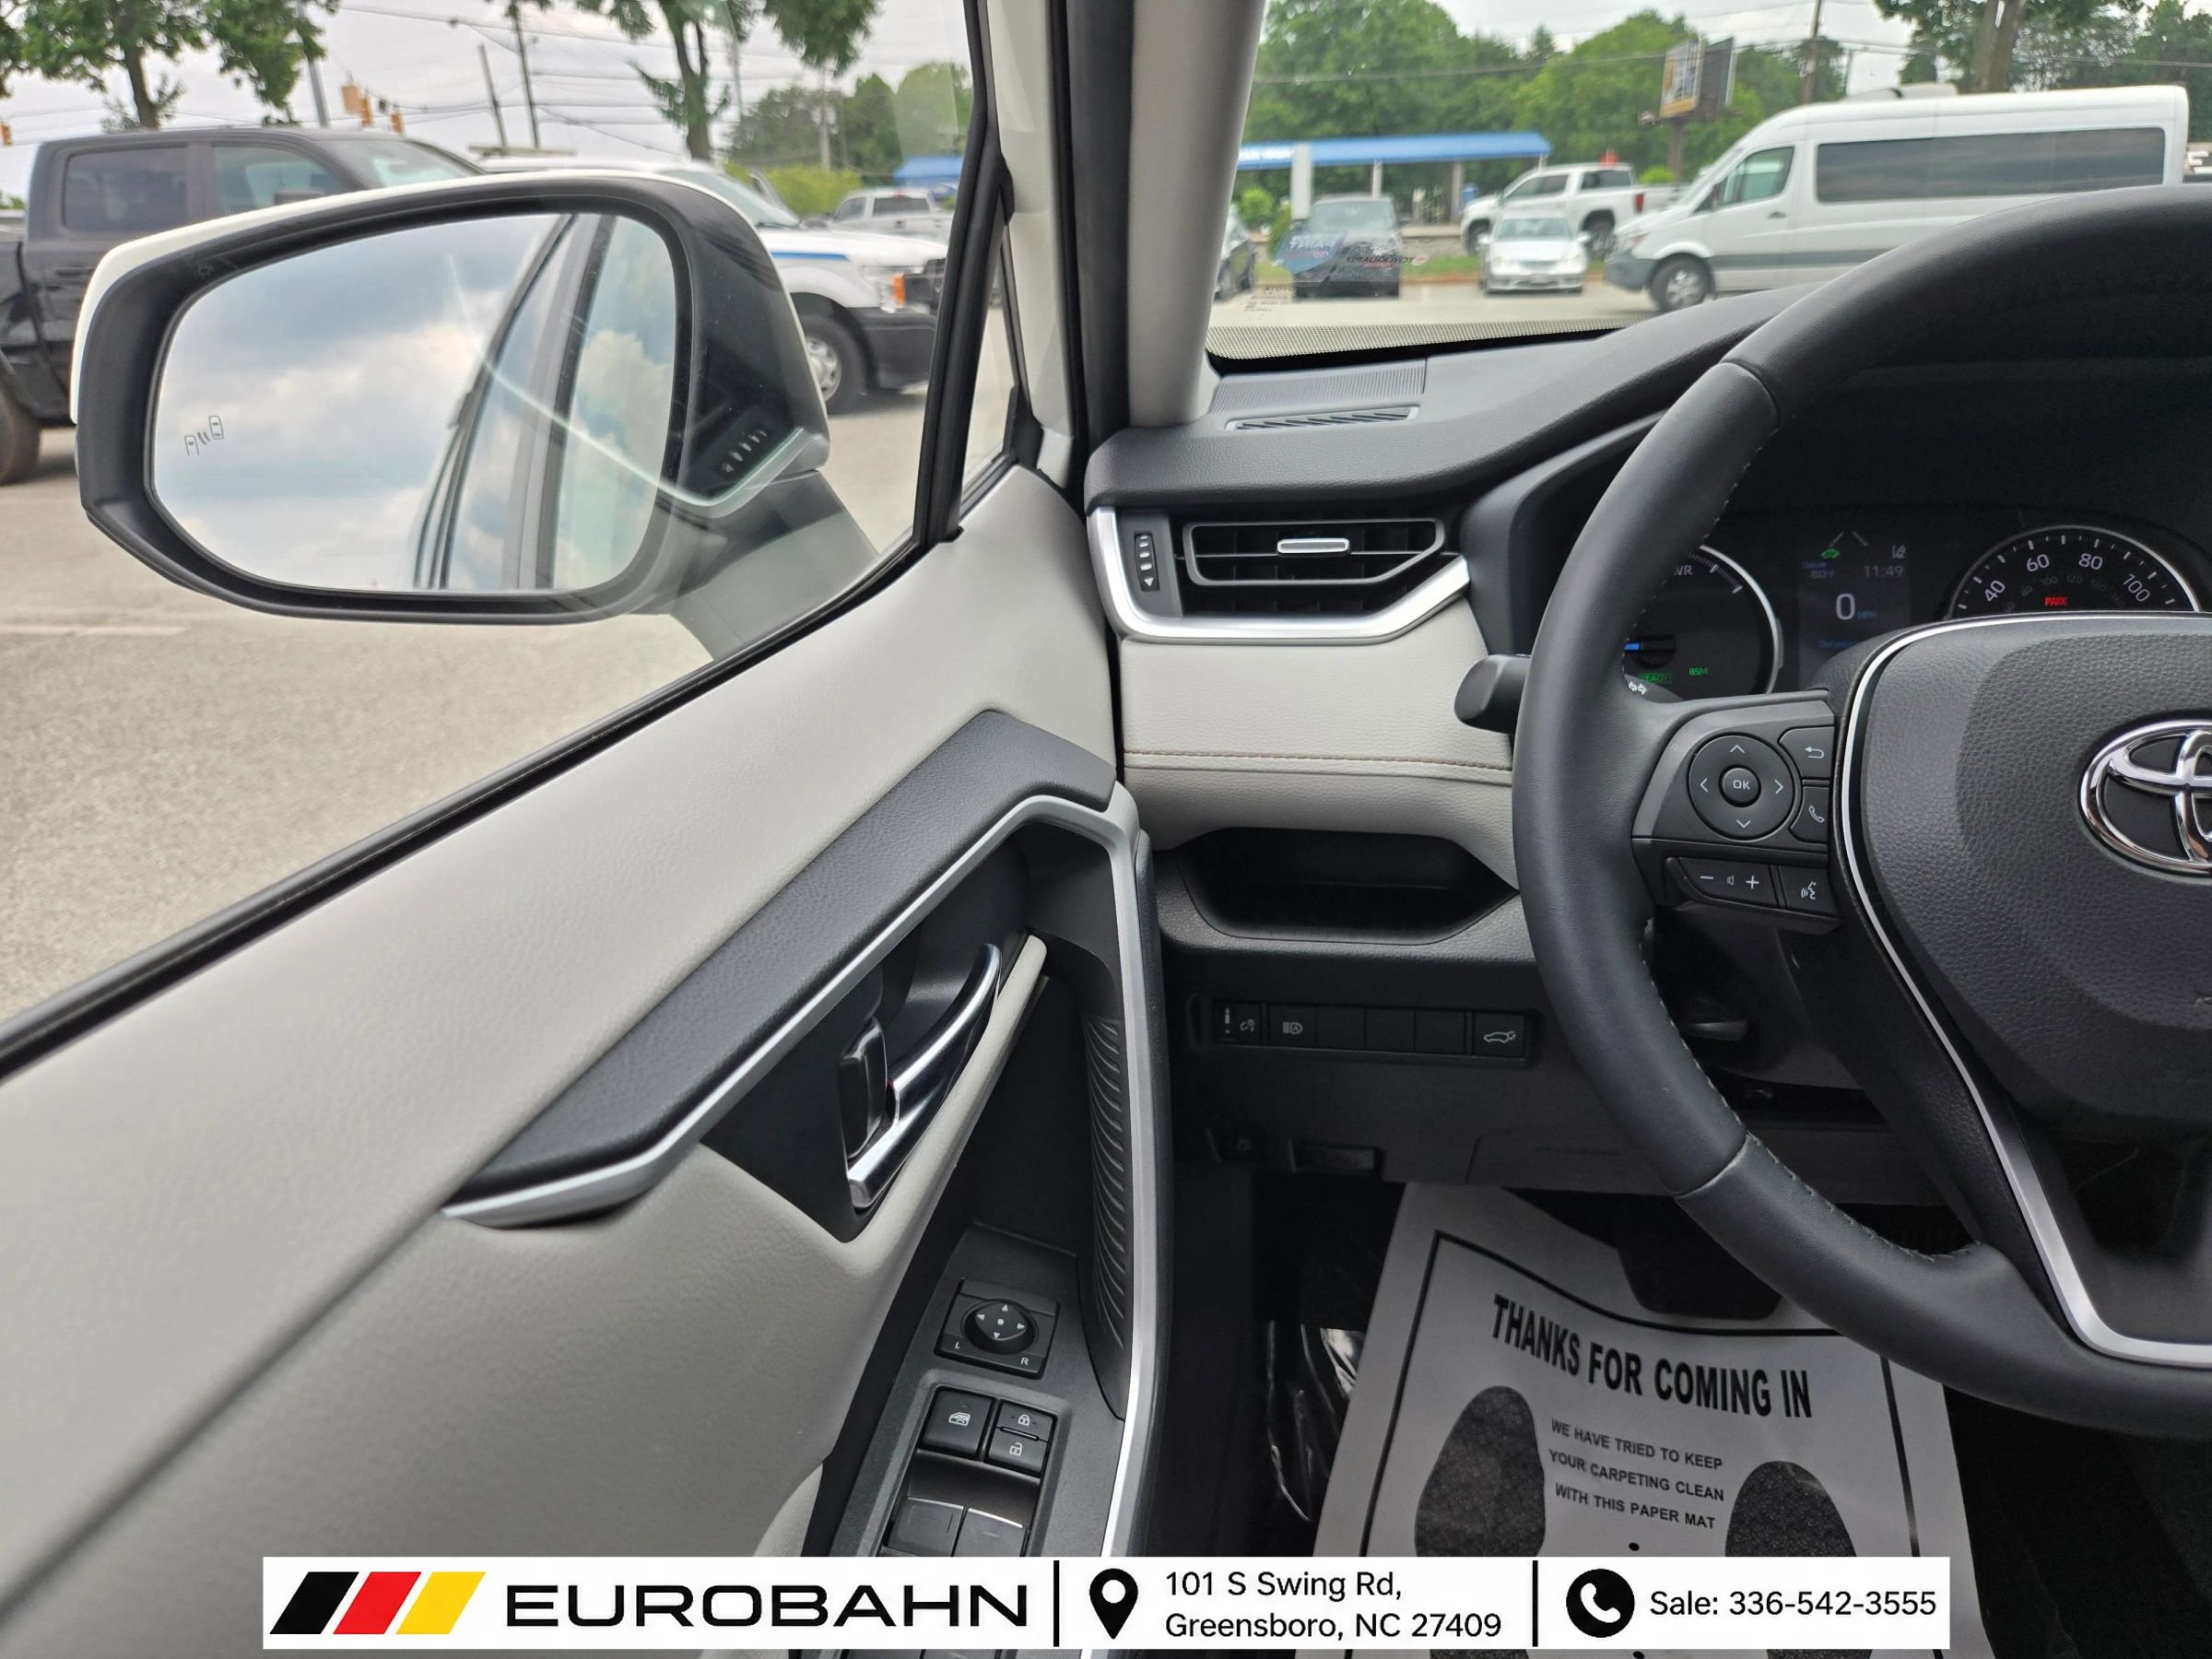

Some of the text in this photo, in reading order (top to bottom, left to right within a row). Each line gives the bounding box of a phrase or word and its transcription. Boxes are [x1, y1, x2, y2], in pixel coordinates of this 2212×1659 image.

[2027, 554, 2050, 572] 60
[2078, 553, 2103, 571] 80
[1864, 565, 1904, 579] 11:49
[1983, 580, 2006, 602] 40
[2123, 573, 2151, 602] 100
[1835, 593, 1856, 620] 0
[2044, 596, 2068, 606] PARK
[1688, 667, 1708, 677] BSM
[1733, 780, 1751, 790] OK
[955, 1341, 960, 1349] L
[1020, 1357, 1030, 1366] R
[1492, 1292, 1812, 1418] THANKS FOR COMING IN
[1551, 1418, 1723, 1470] WE HAVE TRIED TO KEEP
[1549, 1449, 1724, 1501] YOUR CARPETING CLEAN
[1555, 1482, 1715, 1529] WITH THIS PAPER MAT
